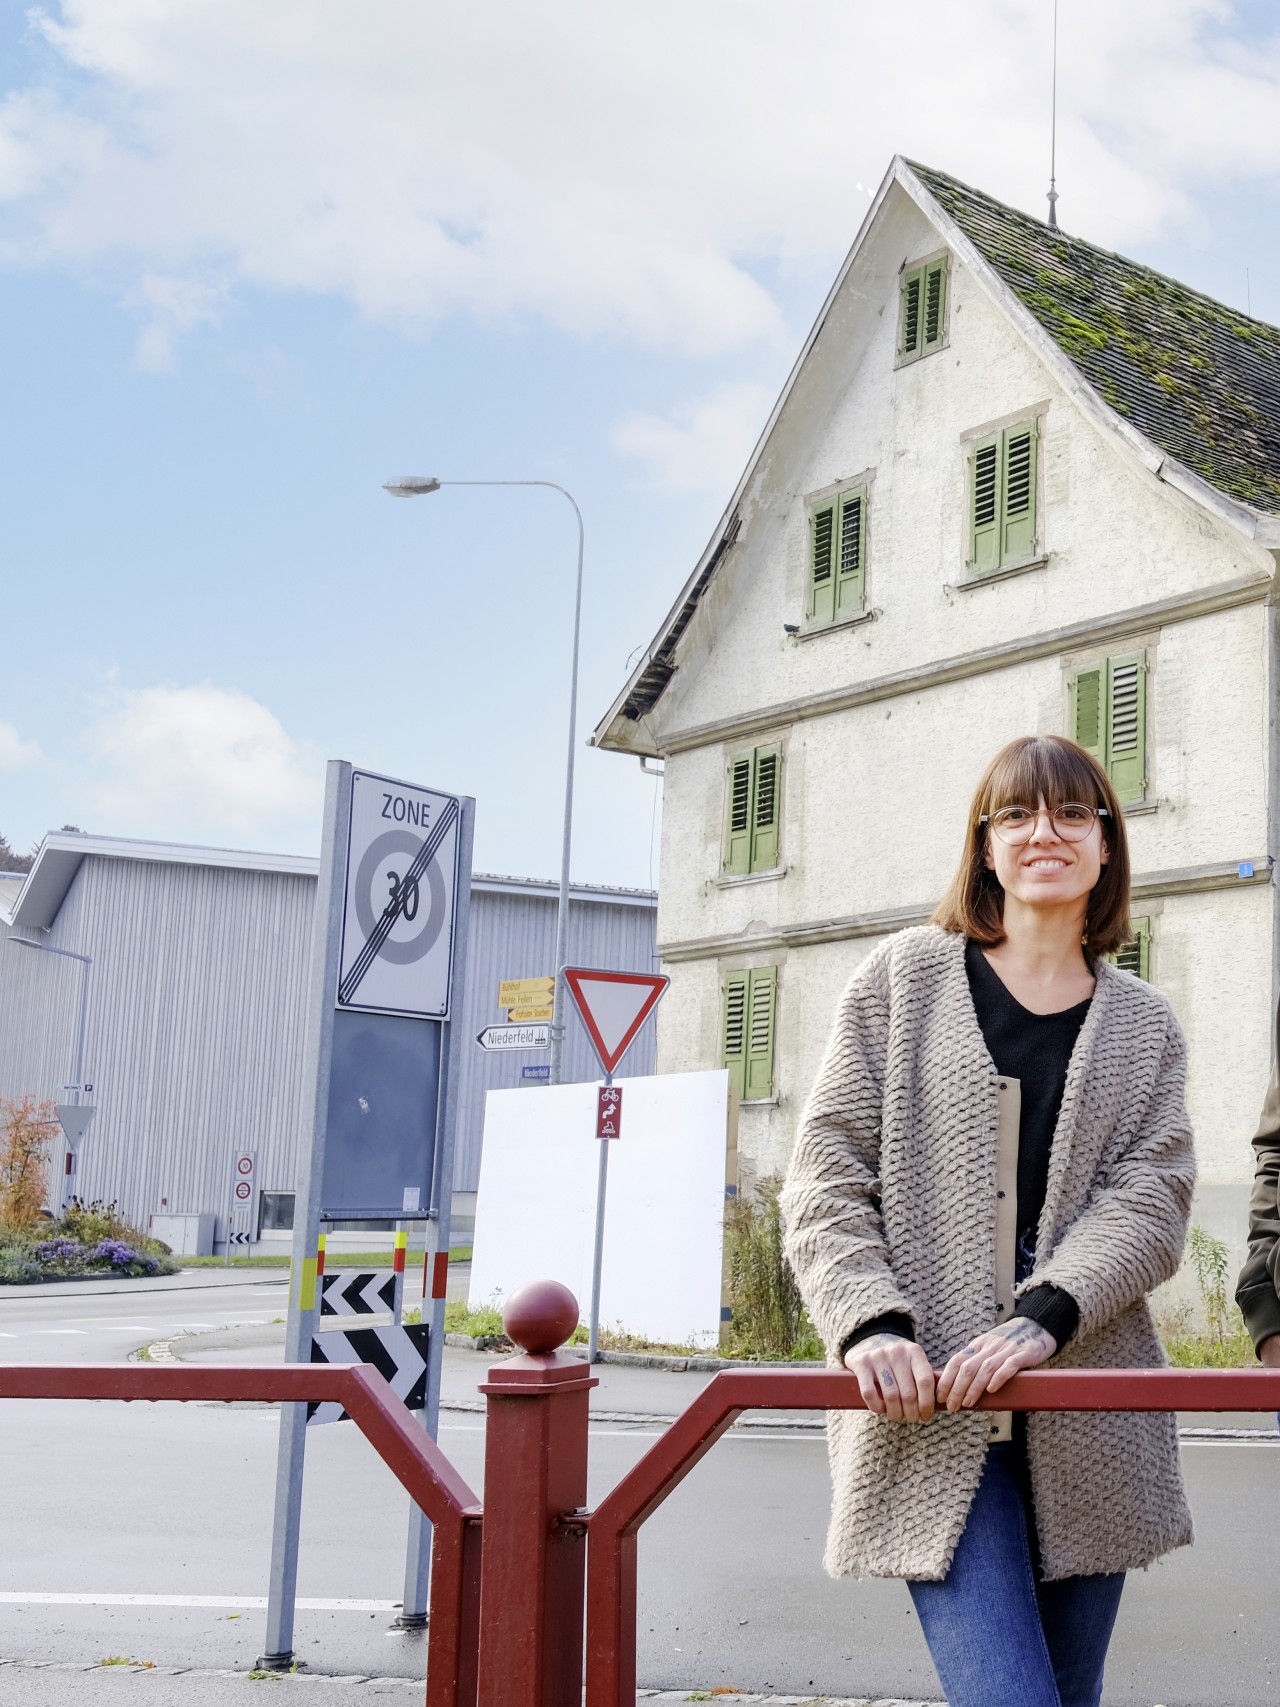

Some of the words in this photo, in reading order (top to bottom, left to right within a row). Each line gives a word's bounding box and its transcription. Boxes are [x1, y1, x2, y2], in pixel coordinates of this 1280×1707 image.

[381, 793, 430, 828] ZONE
[384, 871, 420, 921] 30
[488, 1029, 534, 1044] Niederfeld
